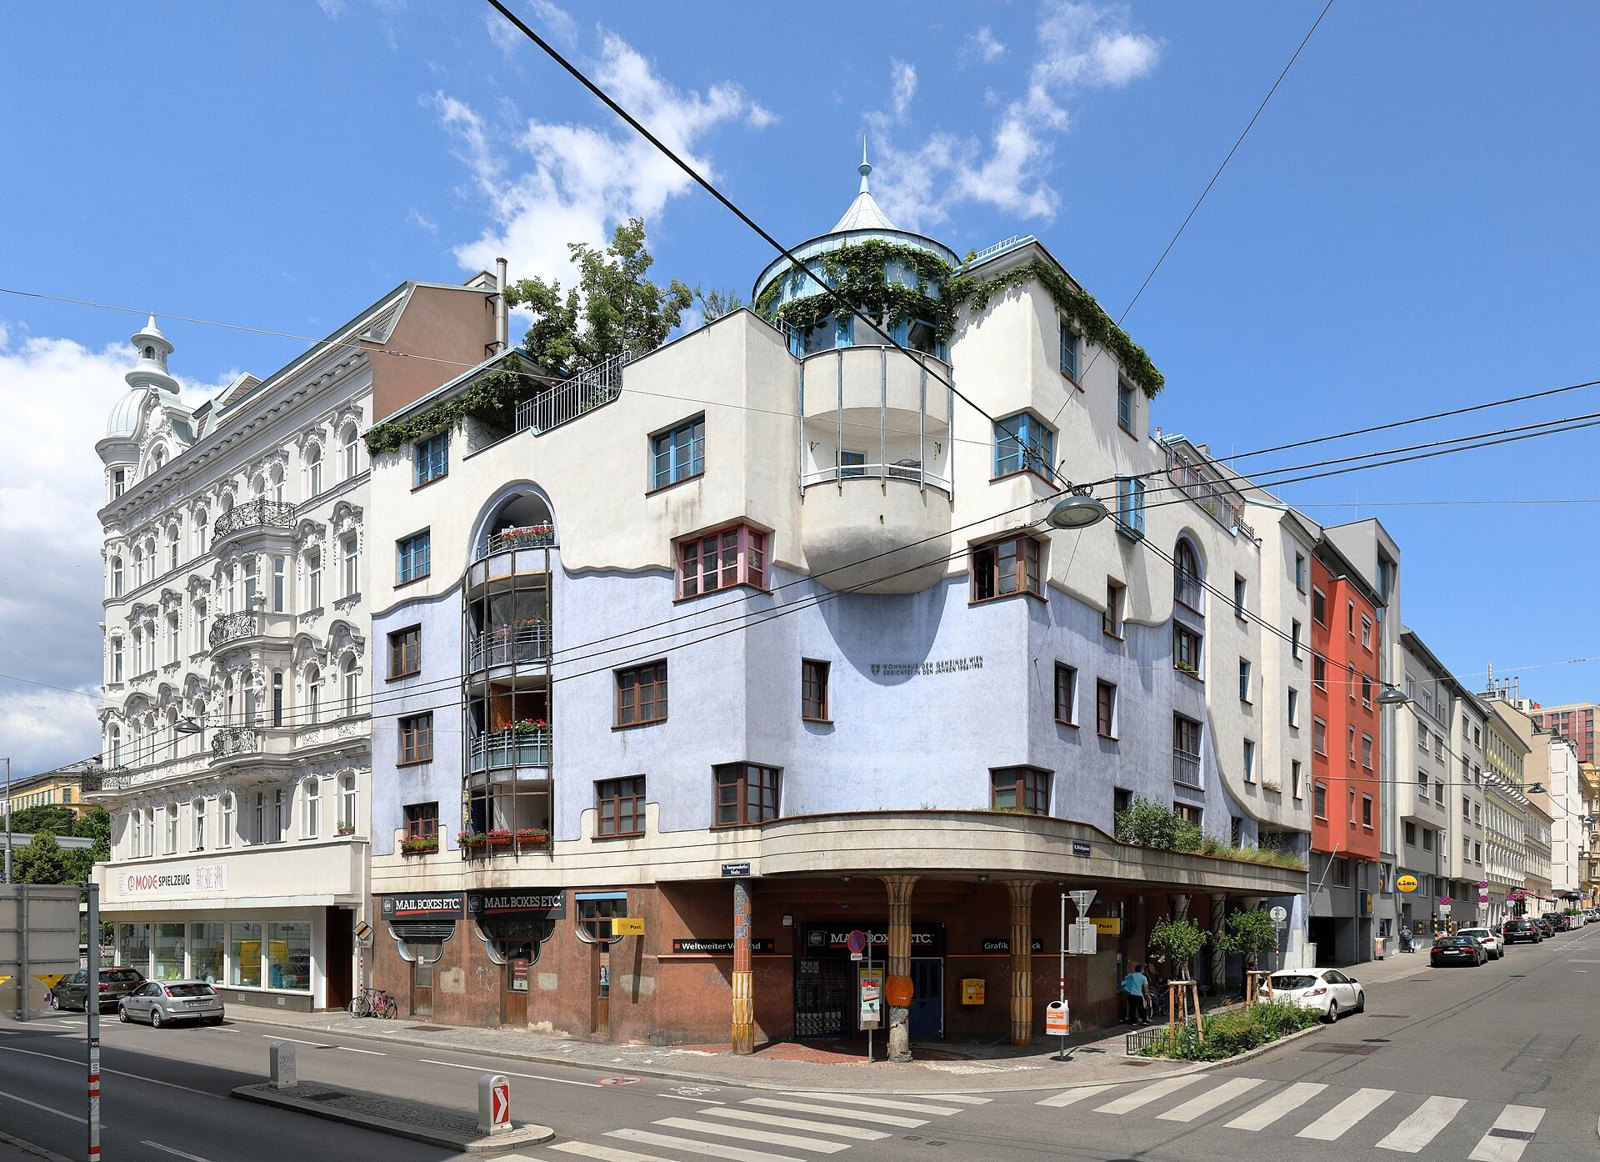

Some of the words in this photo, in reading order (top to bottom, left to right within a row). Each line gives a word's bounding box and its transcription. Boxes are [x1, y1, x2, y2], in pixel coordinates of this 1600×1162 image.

[158, 874, 190, 886] SPIELZEUG
[395, 899, 416, 910] MAIL
[417, 899, 442, 909] BOXES
[484, 897, 509, 908] MAIL
[510, 895, 540, 908] BOXES
